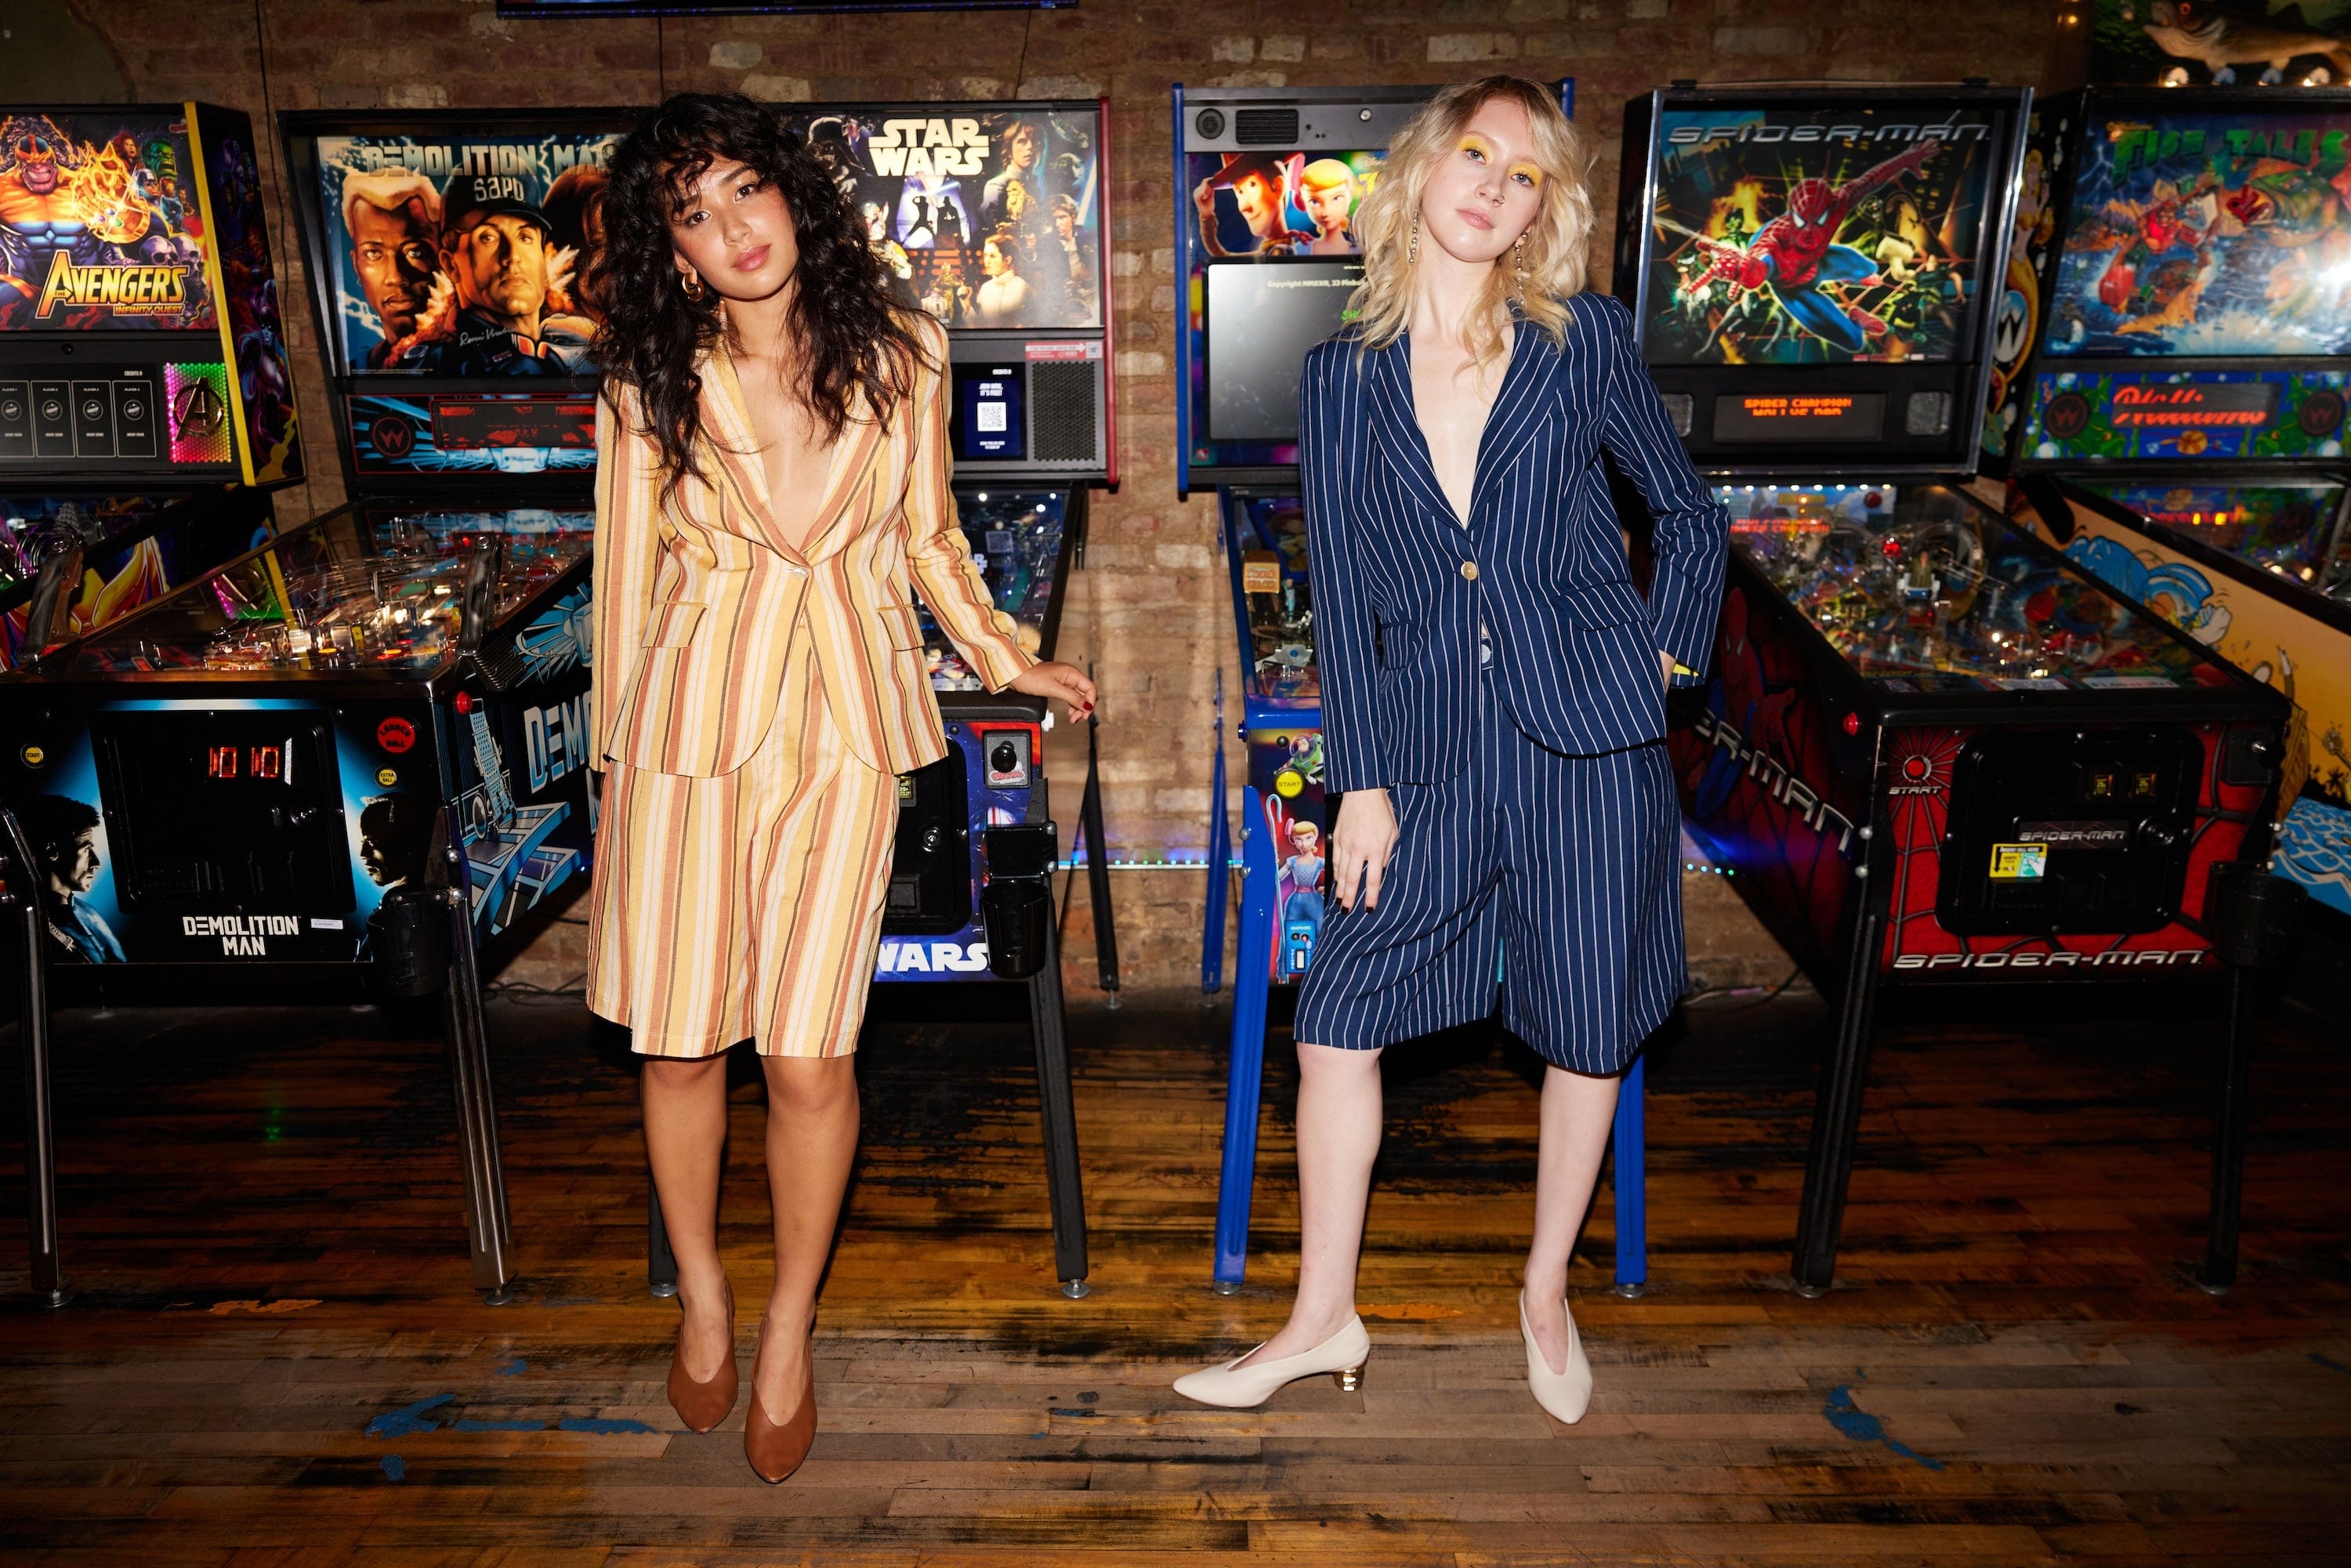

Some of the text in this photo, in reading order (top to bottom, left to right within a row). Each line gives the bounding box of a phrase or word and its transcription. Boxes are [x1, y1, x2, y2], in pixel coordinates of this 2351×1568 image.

[868, 118, 989, 147] STAR
[1668, 125, 1990, 143] SPIDER-MAN
[366, 144, 537, 177] DEMOLITION
[868, 147, 990, 176] WARS
[36, 250, 189, 318] AVENGERS
[115, 306, 183, 315] INFINITY QUEST
[1744, 397, 1852, 408] SPIDER CHAMPION
[1889, 785, 1942, 795] START
[2020, 830, 2125, 842] SPIDER-MAN
[182, 915, 299, 936] DEMOLITION
[223, 936, 266, 955] MAN
[1893, 950, 2203, 969] SPIDER-MAN
